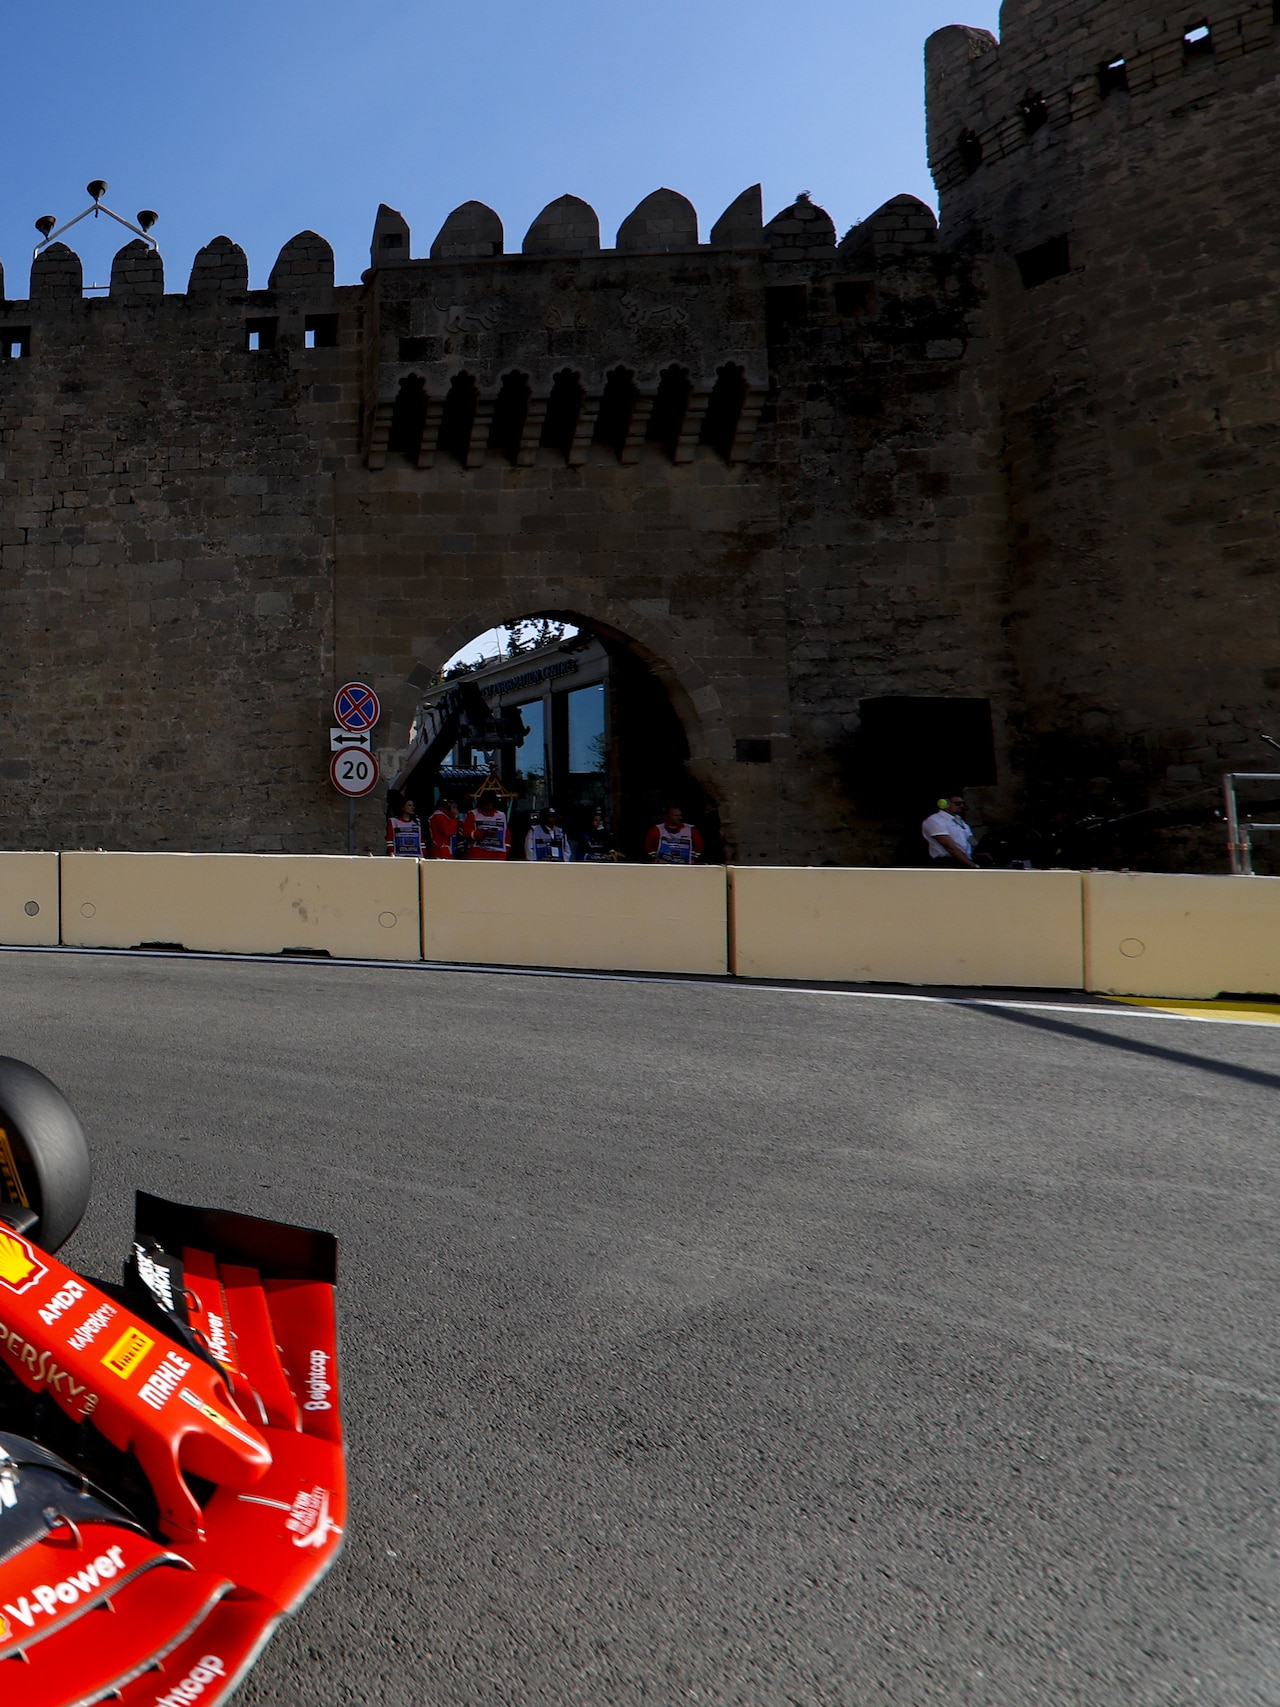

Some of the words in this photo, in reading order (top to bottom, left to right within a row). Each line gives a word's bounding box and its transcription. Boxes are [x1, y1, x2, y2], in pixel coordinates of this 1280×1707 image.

[342, 760, 368, 781] 20
[37, 1288, 77, 1326] AMD
[66, 1305, 113, 1352] KASPERSKY
[110, 1332, 147, 1372] PIRELLI
[207, 1311, 233, 1363] V-Power
[136, 1350, 192, 1411] MAHLE
[2, 1544, 126, 1628] V-Power
